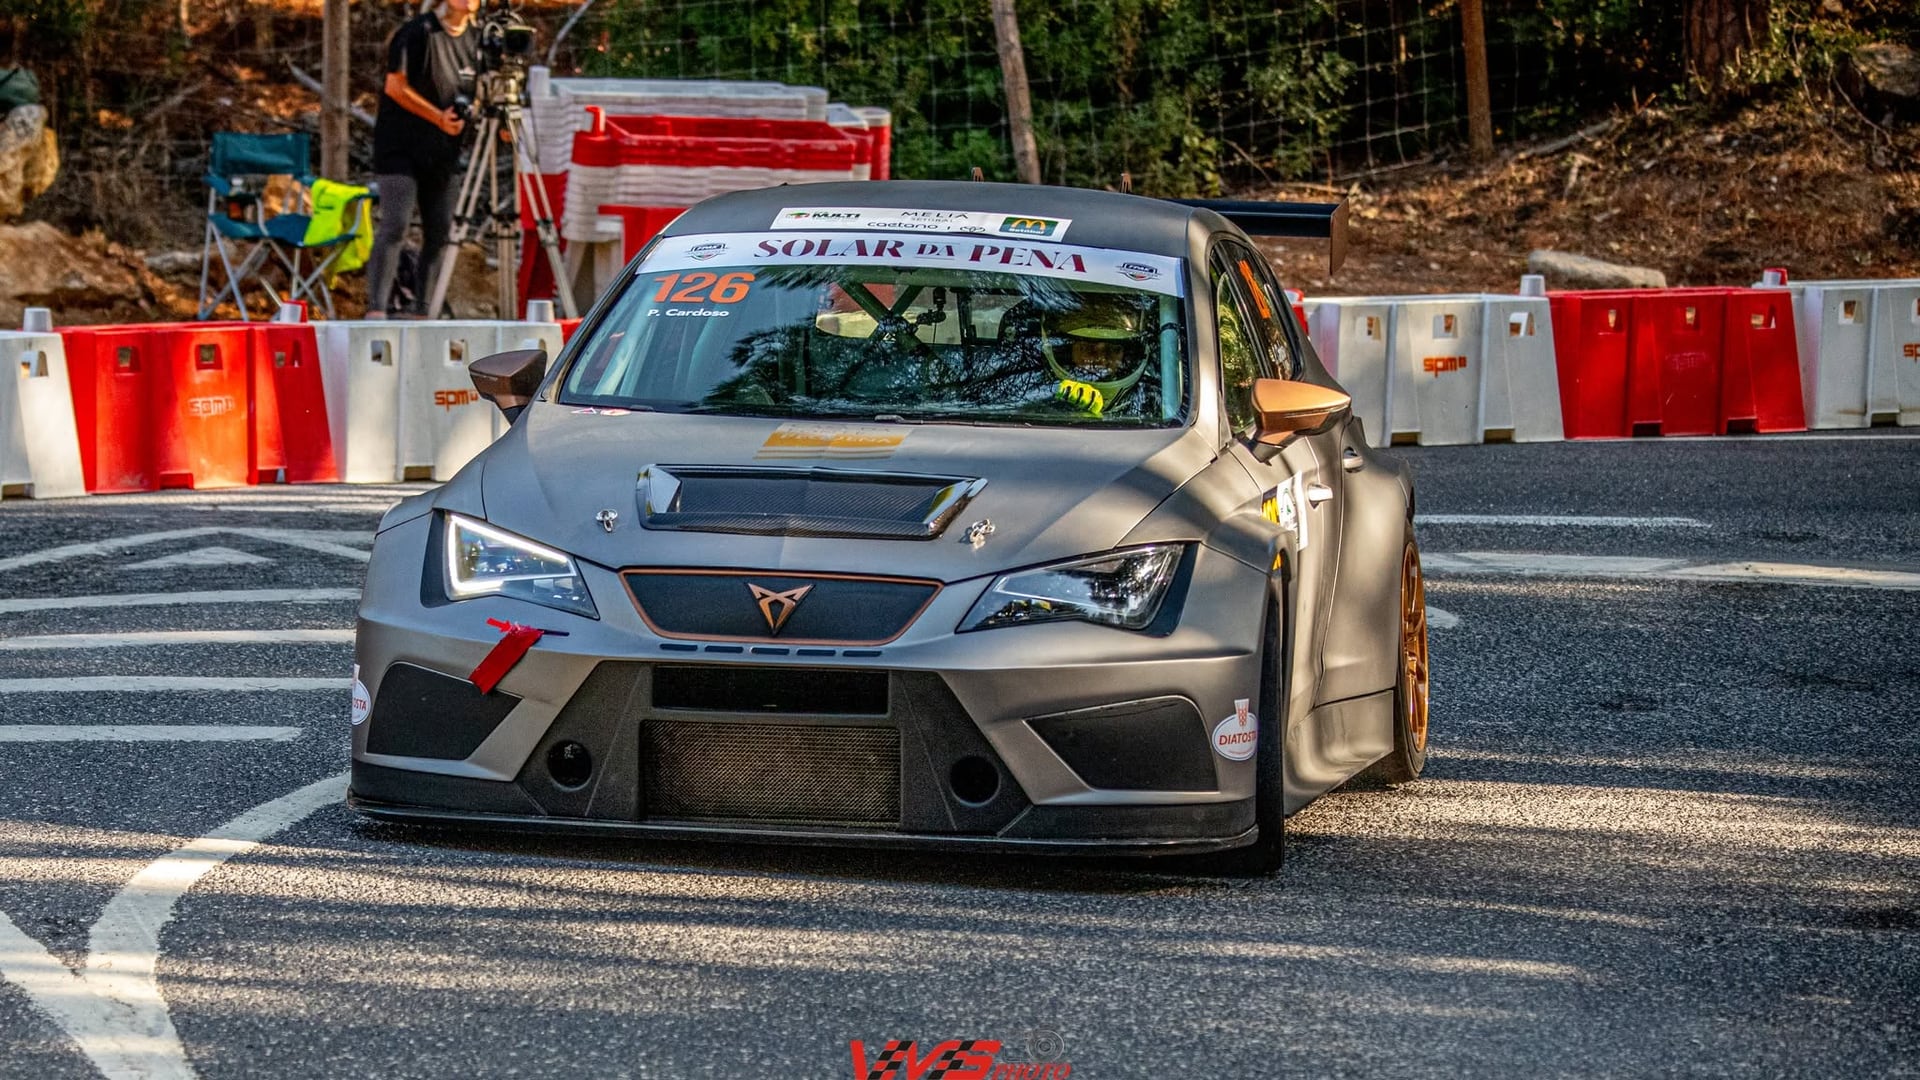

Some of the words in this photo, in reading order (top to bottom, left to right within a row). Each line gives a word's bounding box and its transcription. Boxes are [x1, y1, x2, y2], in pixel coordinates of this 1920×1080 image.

[867, 221, 939, 229] caetano
[753, 239, 905, 258] SOLAR
[916, 243, 956, 257] DA
[968, 243, 1088, 273] PENA
[652, 271, 756, 305] 126
[647, 308, 660, 317] P.
[665, 308, 730, 317] Cardoso
